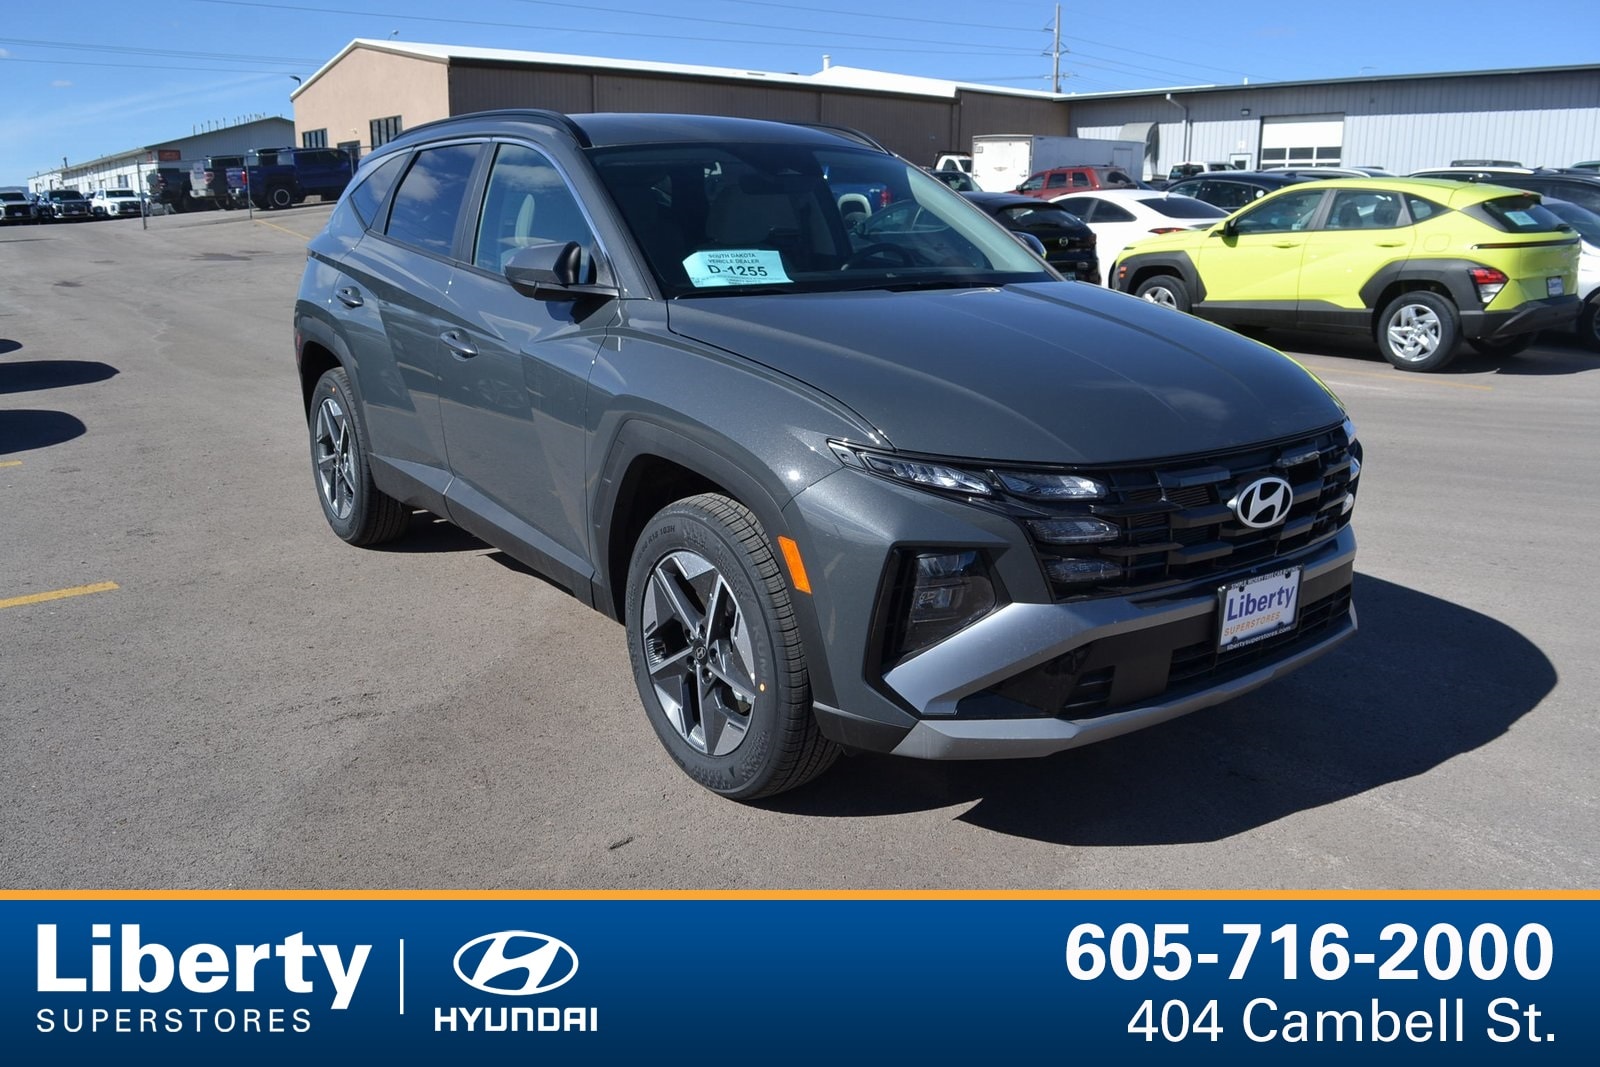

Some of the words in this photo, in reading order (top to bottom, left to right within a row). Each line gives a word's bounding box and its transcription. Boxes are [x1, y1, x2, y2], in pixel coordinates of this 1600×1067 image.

[707, 265, 768, 276] D-1255
[1227, 585, 1295, 621] Liberty
[1224, 611, 1281, 636] SUPERSTORES
